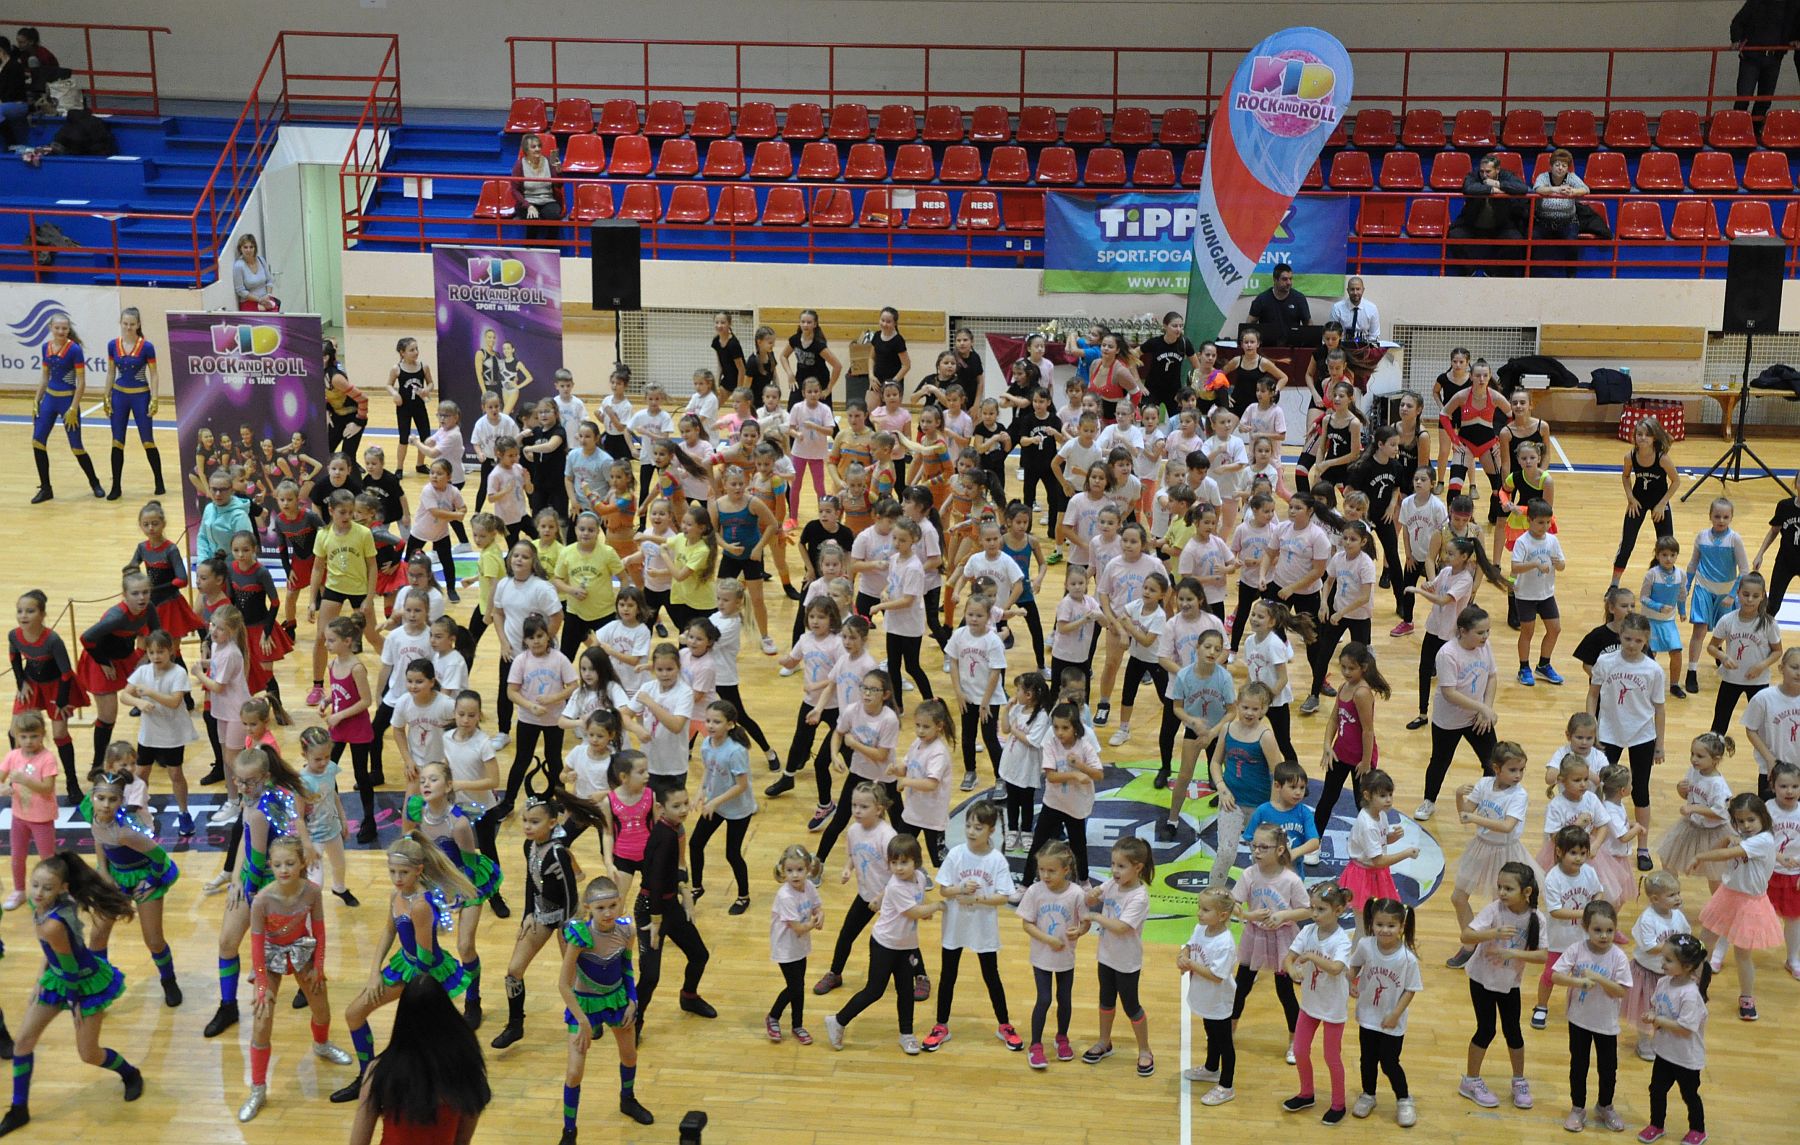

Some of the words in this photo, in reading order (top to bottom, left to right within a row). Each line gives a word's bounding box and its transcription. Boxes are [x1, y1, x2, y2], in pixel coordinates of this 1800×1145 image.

[1249, 57, 1336, 100] KID
[1097, 249, 1192, 263] SPORT.FOGA
[1200, 213, 1244, 287] HUNGARY
[468, 258, 525, 286] KID
[211, 325, 281, 355] KID
[223, 376, 247, 385] SPORT
